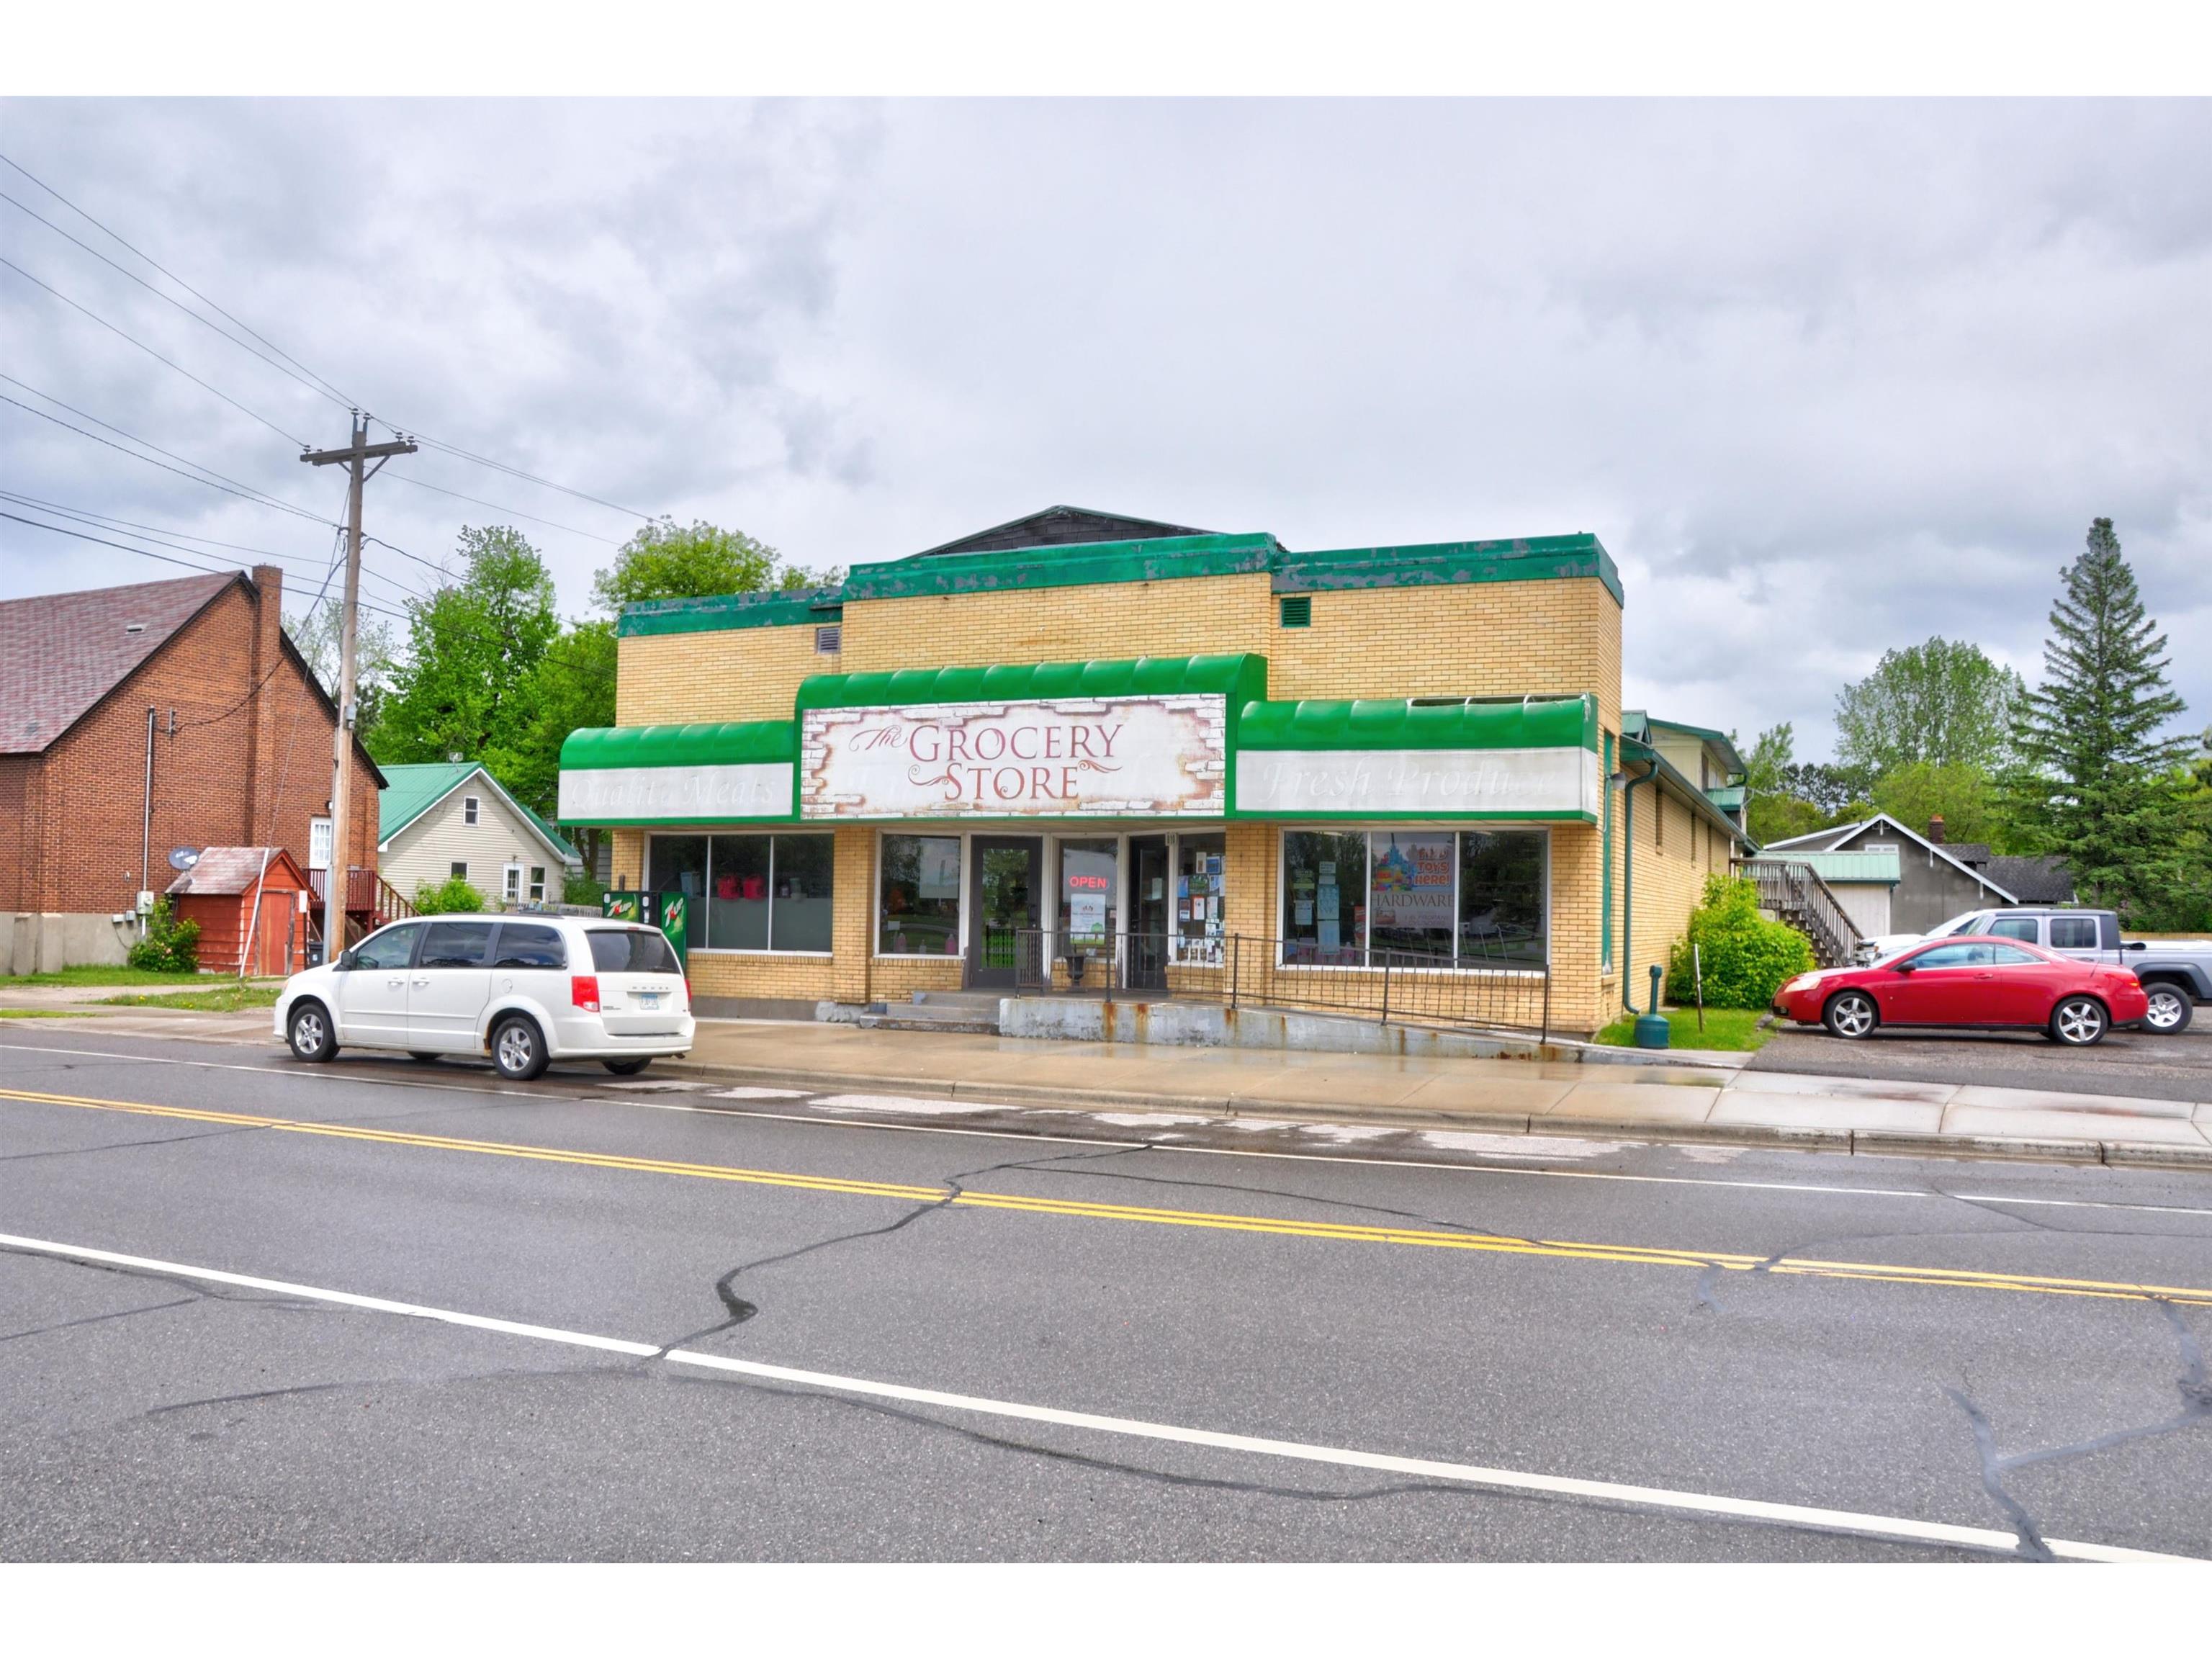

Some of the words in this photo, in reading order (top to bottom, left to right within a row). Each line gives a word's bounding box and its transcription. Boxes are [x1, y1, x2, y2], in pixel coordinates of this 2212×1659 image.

[849, 724, 908, 752] The
[909, 724, 1124, 763] GROCERY
[682, 770, 775, 806] Meats
[943, 763, 1079, 801] STORE
[1259, 756, 1372, 802] Fresh
[1070, 875, 1107, 889] OPEN
[1417, 862, 1449, 872] TOYS
